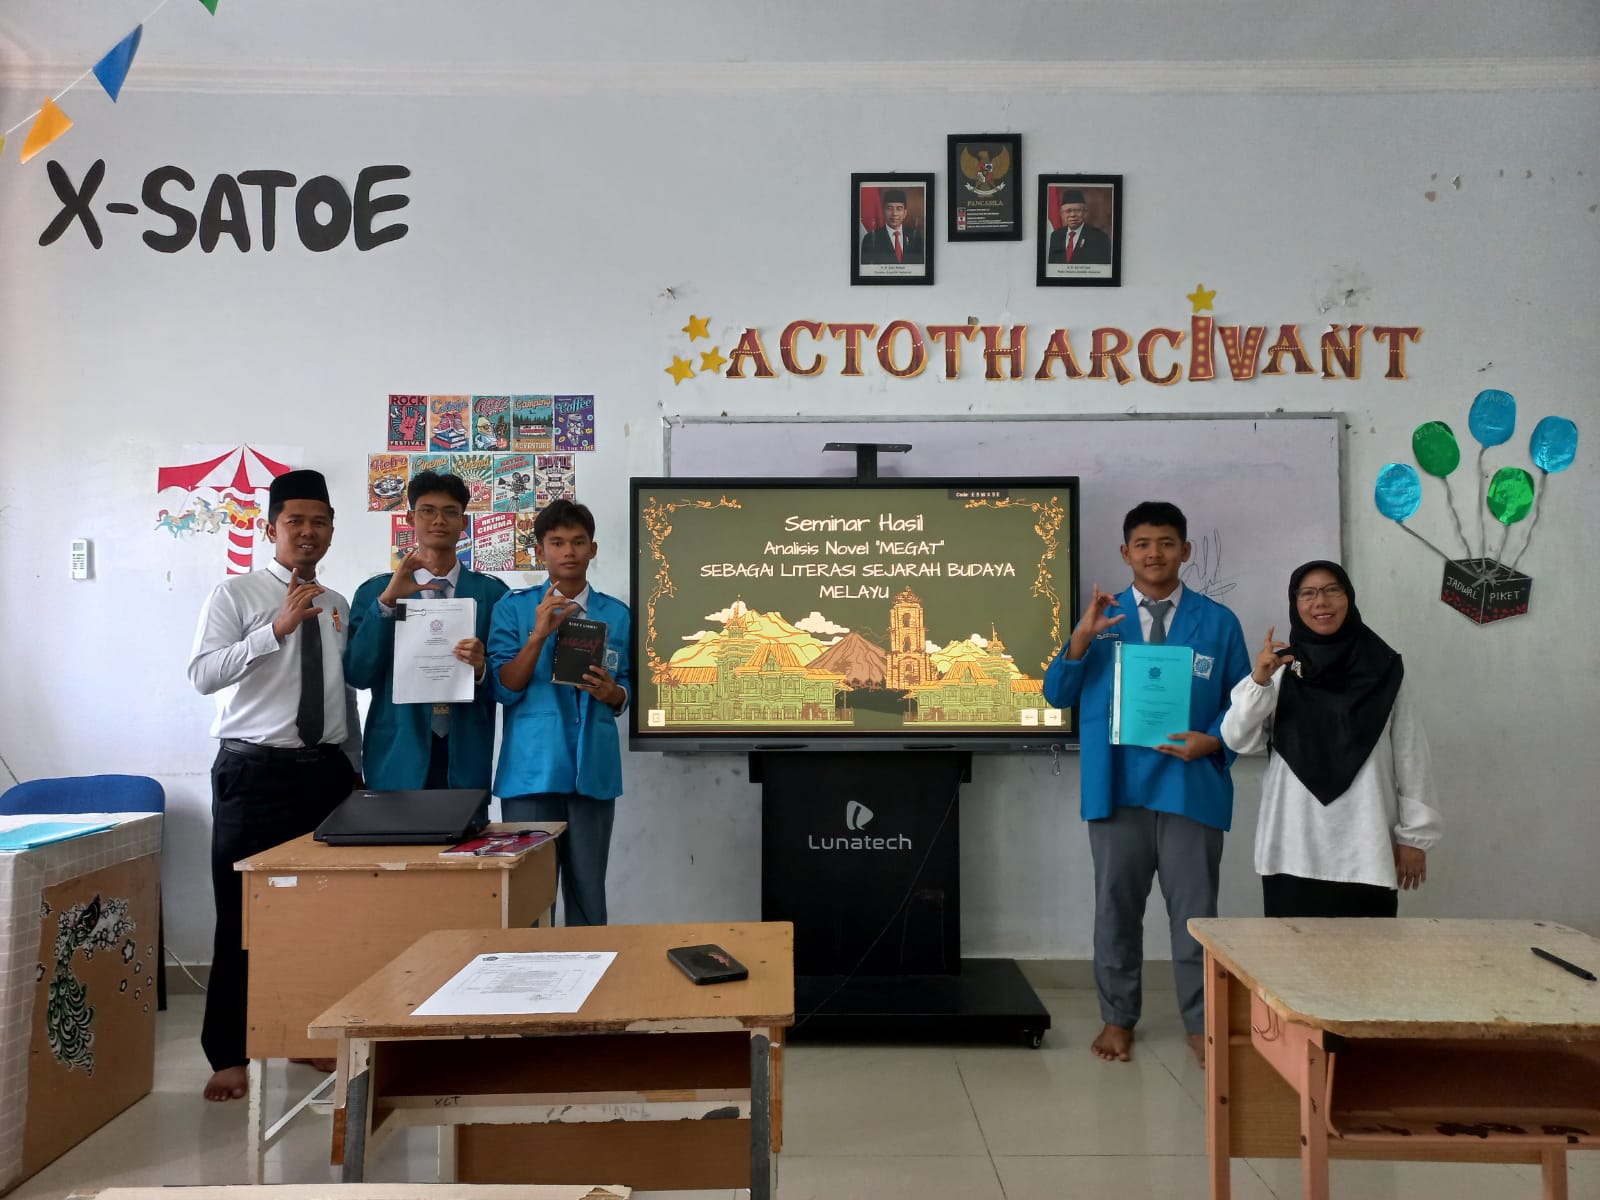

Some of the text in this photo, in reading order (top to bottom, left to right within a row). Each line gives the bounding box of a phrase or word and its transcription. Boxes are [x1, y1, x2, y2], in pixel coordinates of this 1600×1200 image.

[39, 159, 410, 253] X-SATOE
[725, 315, 1421, 386] ACTOTHARCIVANT
[391, 396, 425, 405] ROCK
[556, 397, 593, 414] Coffee
[477, 519, 513, 534] CINEMA
[481, 514, 506, 526] RETRO
[785, 513, 923, 532] Seminar Hasil
[764, 539, 944, 556] Analisis Novel "MEGAT"
[701, 562, 1016, 578] SEBAGAI LITERASI SEJARAH BUDAYA
[819, 584, 889, 600] MELAYU
[1447, 576, 1477, 600] JADWAL
[1490, 590, 1520, 604] PIKET
[808, 833, 912, 850] Lunatech
